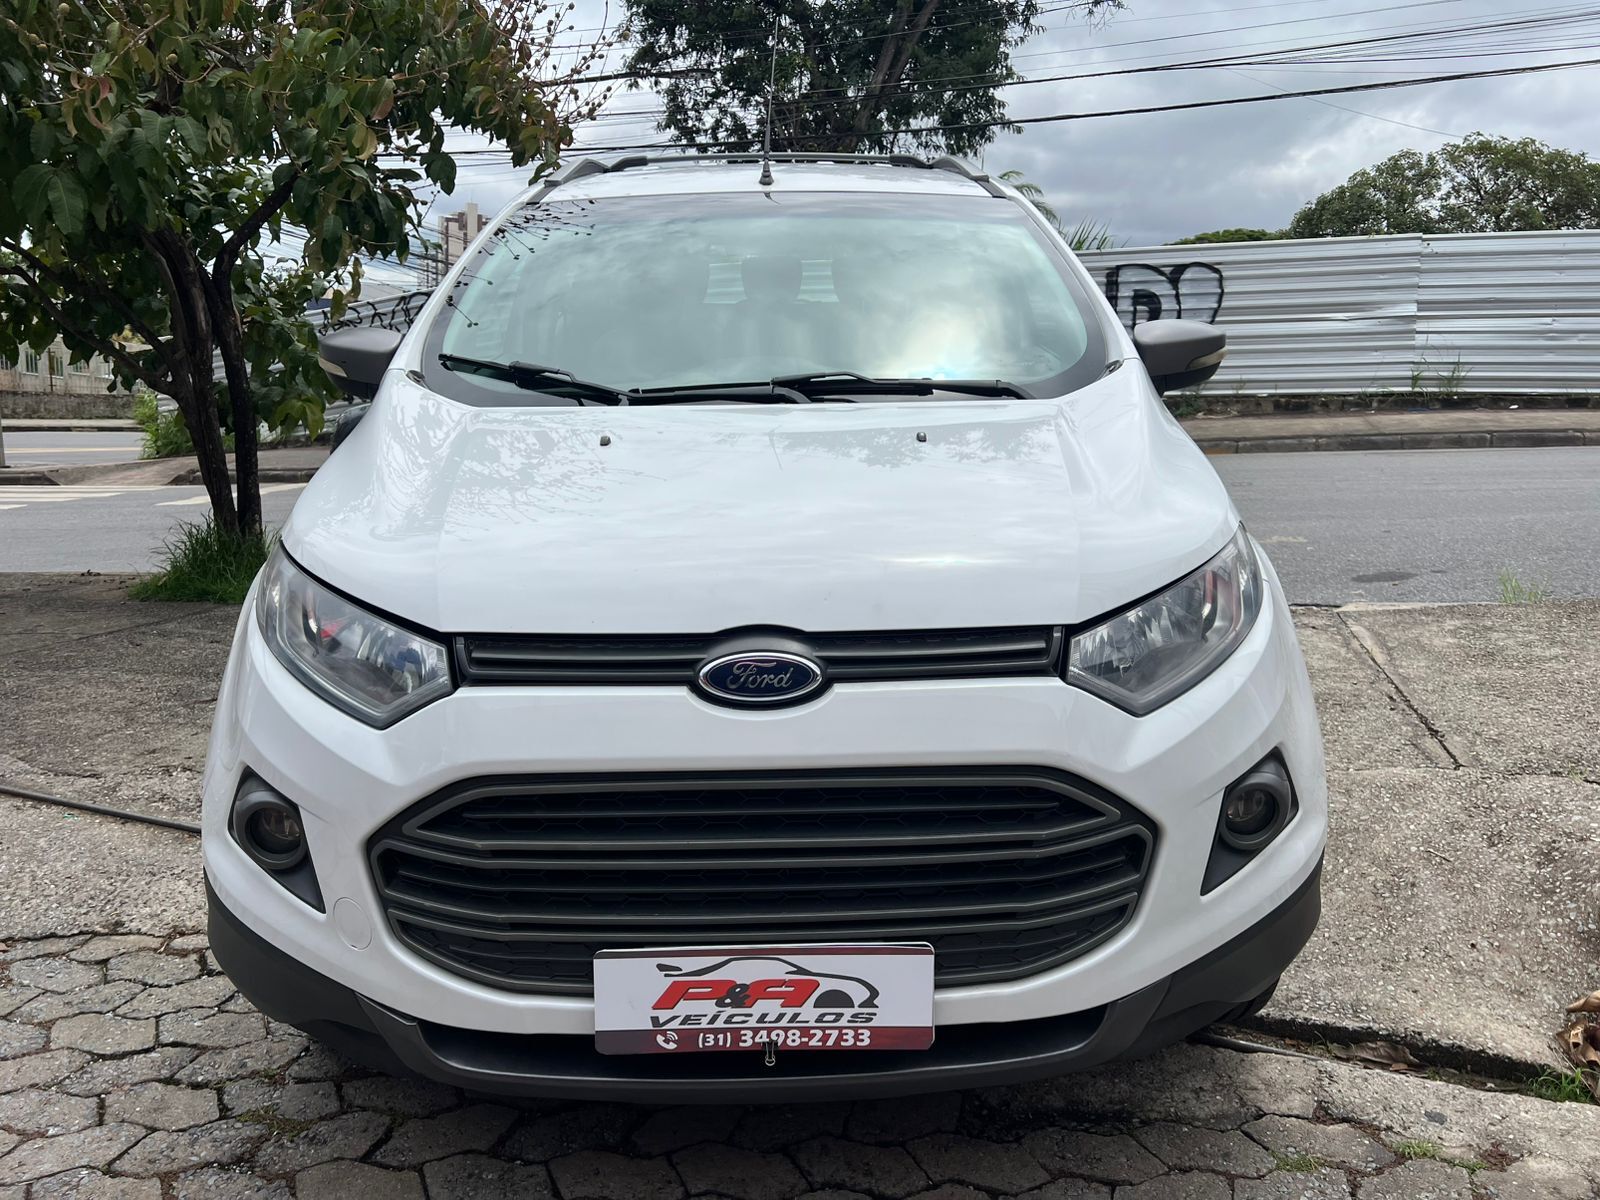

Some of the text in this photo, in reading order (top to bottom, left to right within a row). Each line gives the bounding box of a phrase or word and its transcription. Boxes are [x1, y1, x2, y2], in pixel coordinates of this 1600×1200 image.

[726, 661, 795, 689] Ford
[651, 978, 821, 1010] P&A
[650, 1009, 878, 1028] VEÍCULOS
[698, 1028, 871, 1048] (31) 3498-2733
